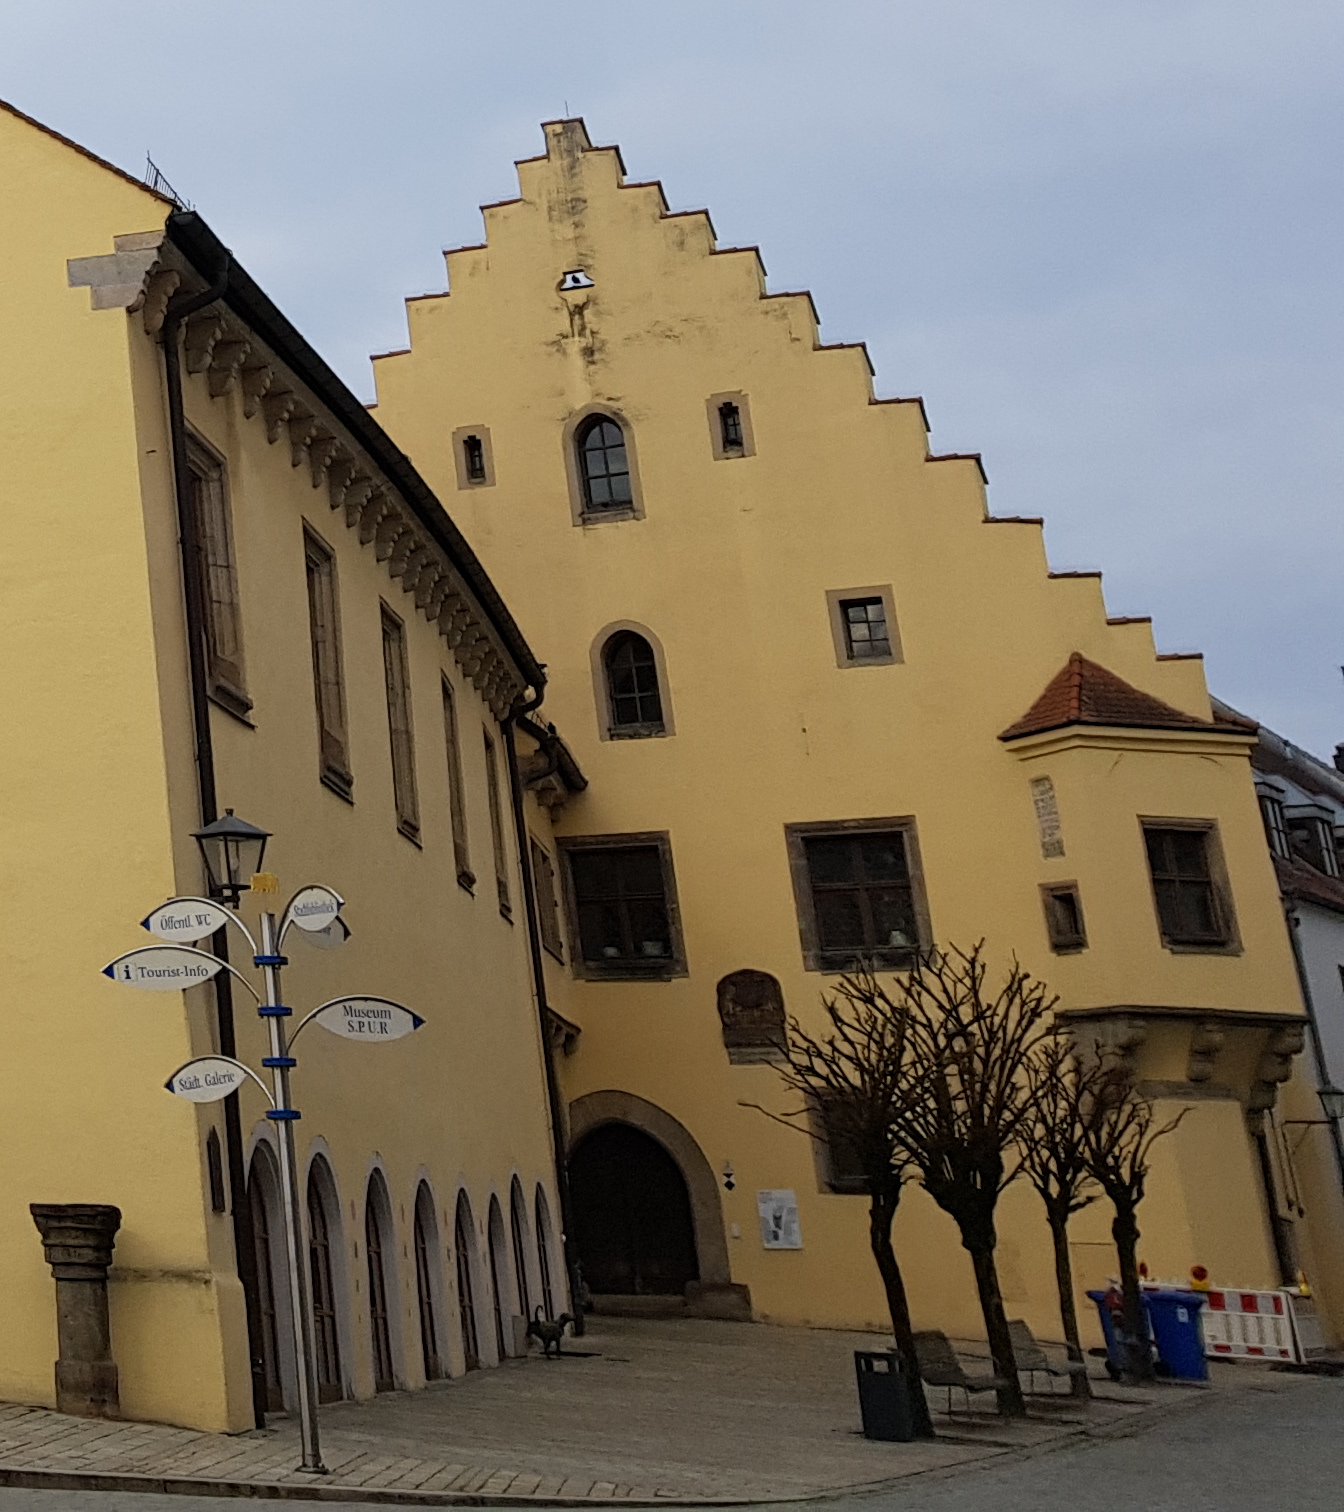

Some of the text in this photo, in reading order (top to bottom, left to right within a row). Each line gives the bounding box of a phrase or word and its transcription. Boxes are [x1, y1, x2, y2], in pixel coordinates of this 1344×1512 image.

[195, 913, 211, 926] WC
[138, 964, 209, 978] Tourist-Info
[343, 1005, 392, 1020] Museum
[205, 1070, 234, 1086] Galerie
